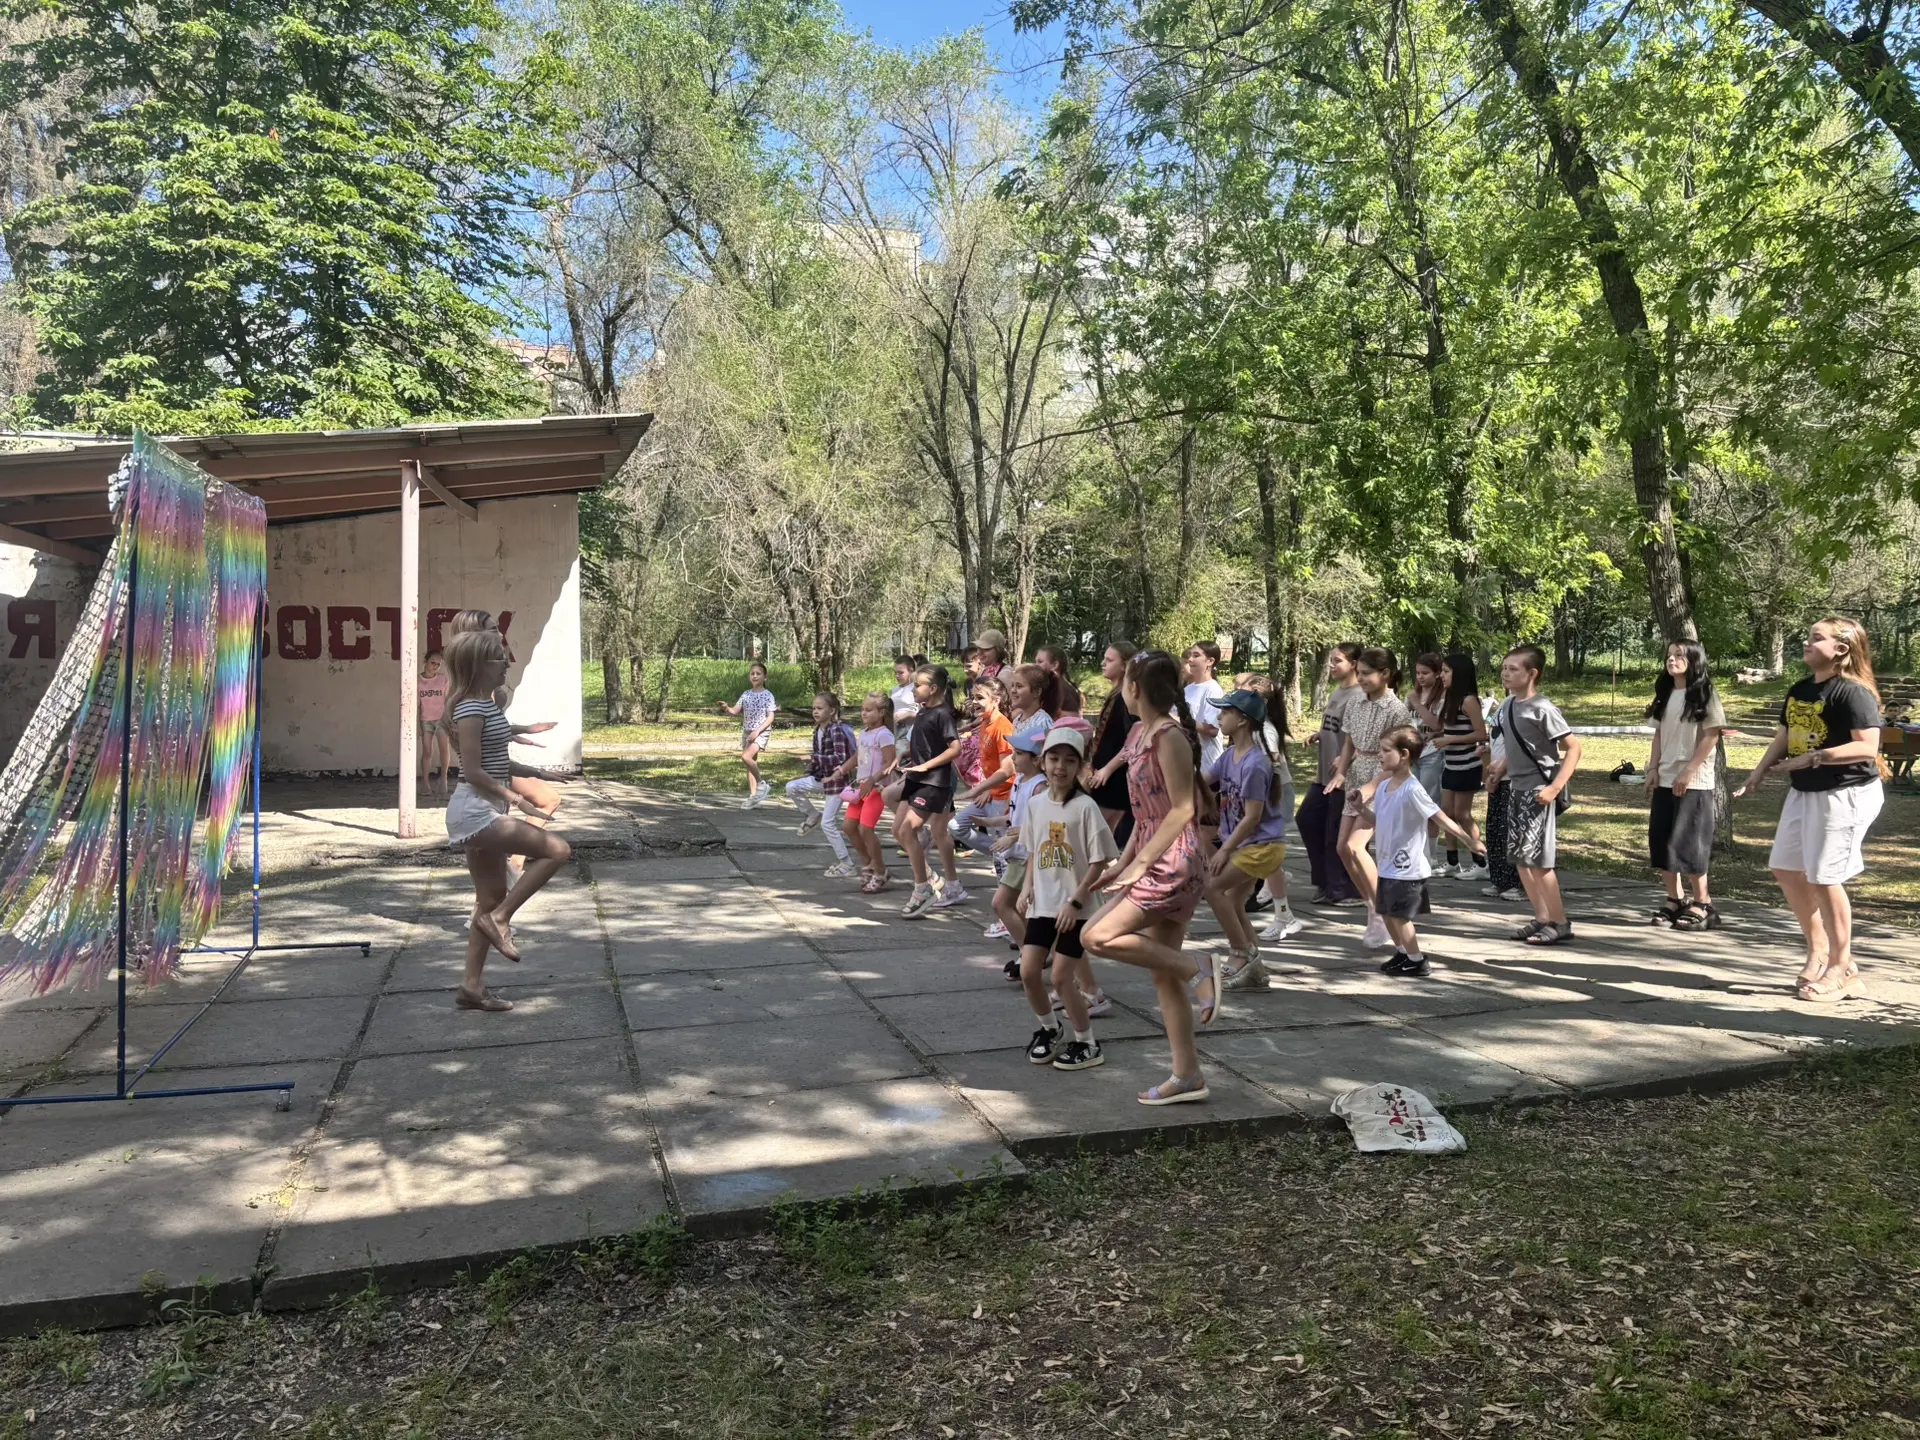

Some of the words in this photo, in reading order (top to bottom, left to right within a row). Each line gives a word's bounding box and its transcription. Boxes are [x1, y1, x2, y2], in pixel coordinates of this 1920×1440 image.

[7, 599, 56, 659] Я
[256, 604, 517, 663] ОСТ
[1038, 846, 1076, 871] GAP
